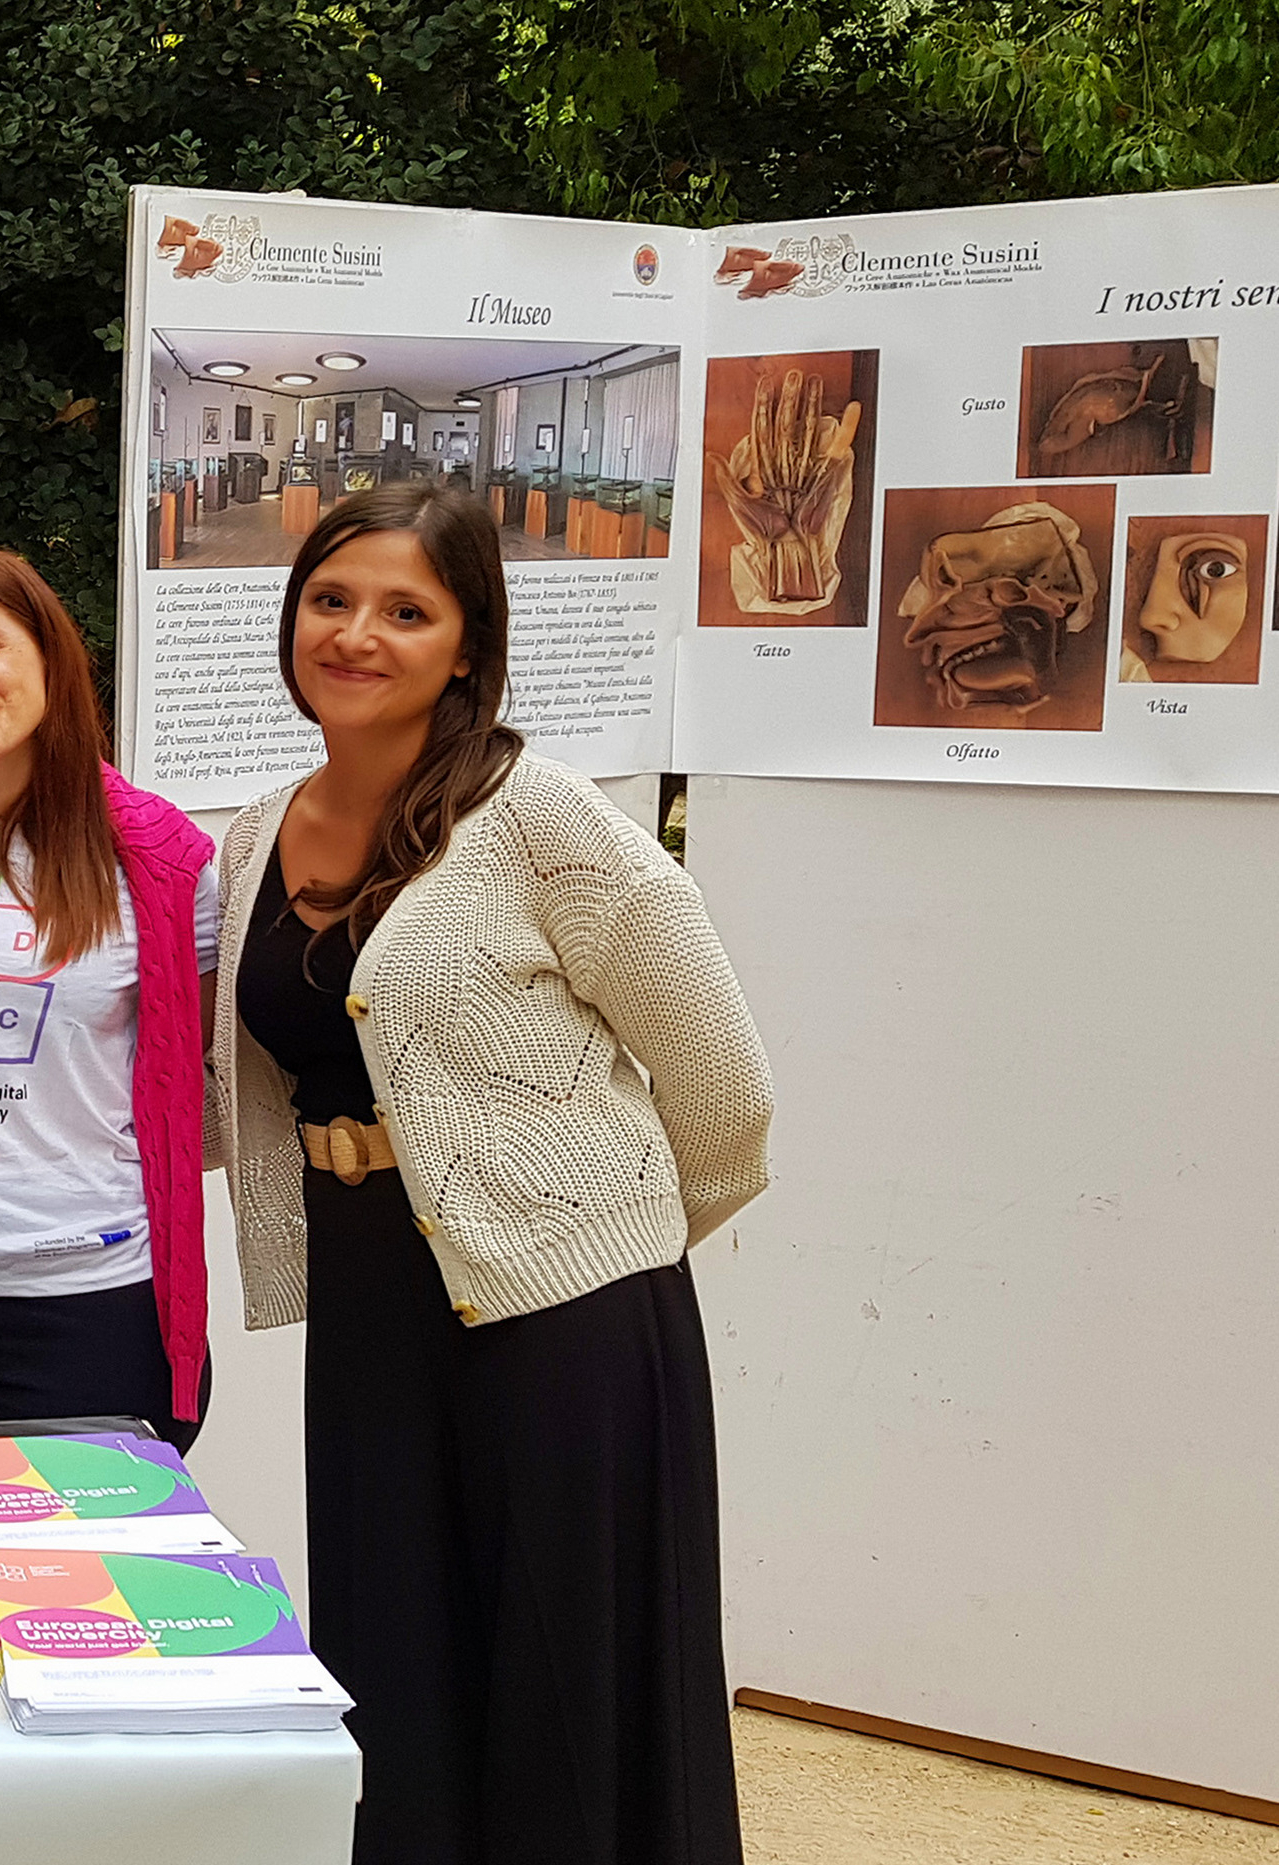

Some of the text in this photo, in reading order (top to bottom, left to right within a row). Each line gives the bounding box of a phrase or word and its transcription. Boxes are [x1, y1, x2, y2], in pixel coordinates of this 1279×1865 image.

[250, 237, 381, 266] Clemente Susini
[842, 241, 1039, 273] Clemente Susini
[1095, 285, 1119, 315] I
[1123, 279, 1224, 312] nostri
[466, 294, 552, 328] Il Museo
[961, 395, 1005, 416] Gusto
[753, 642, 792, 659] Tatto
[1146, 697, 1188, 716] Vista
[945, 742, 1000, 762] Olfatto
[62, 1485, 138, 1498] Digital
[15, 1617, 233, 1632] European Digital
[21, 1629, 161, 1641] UniverCity
